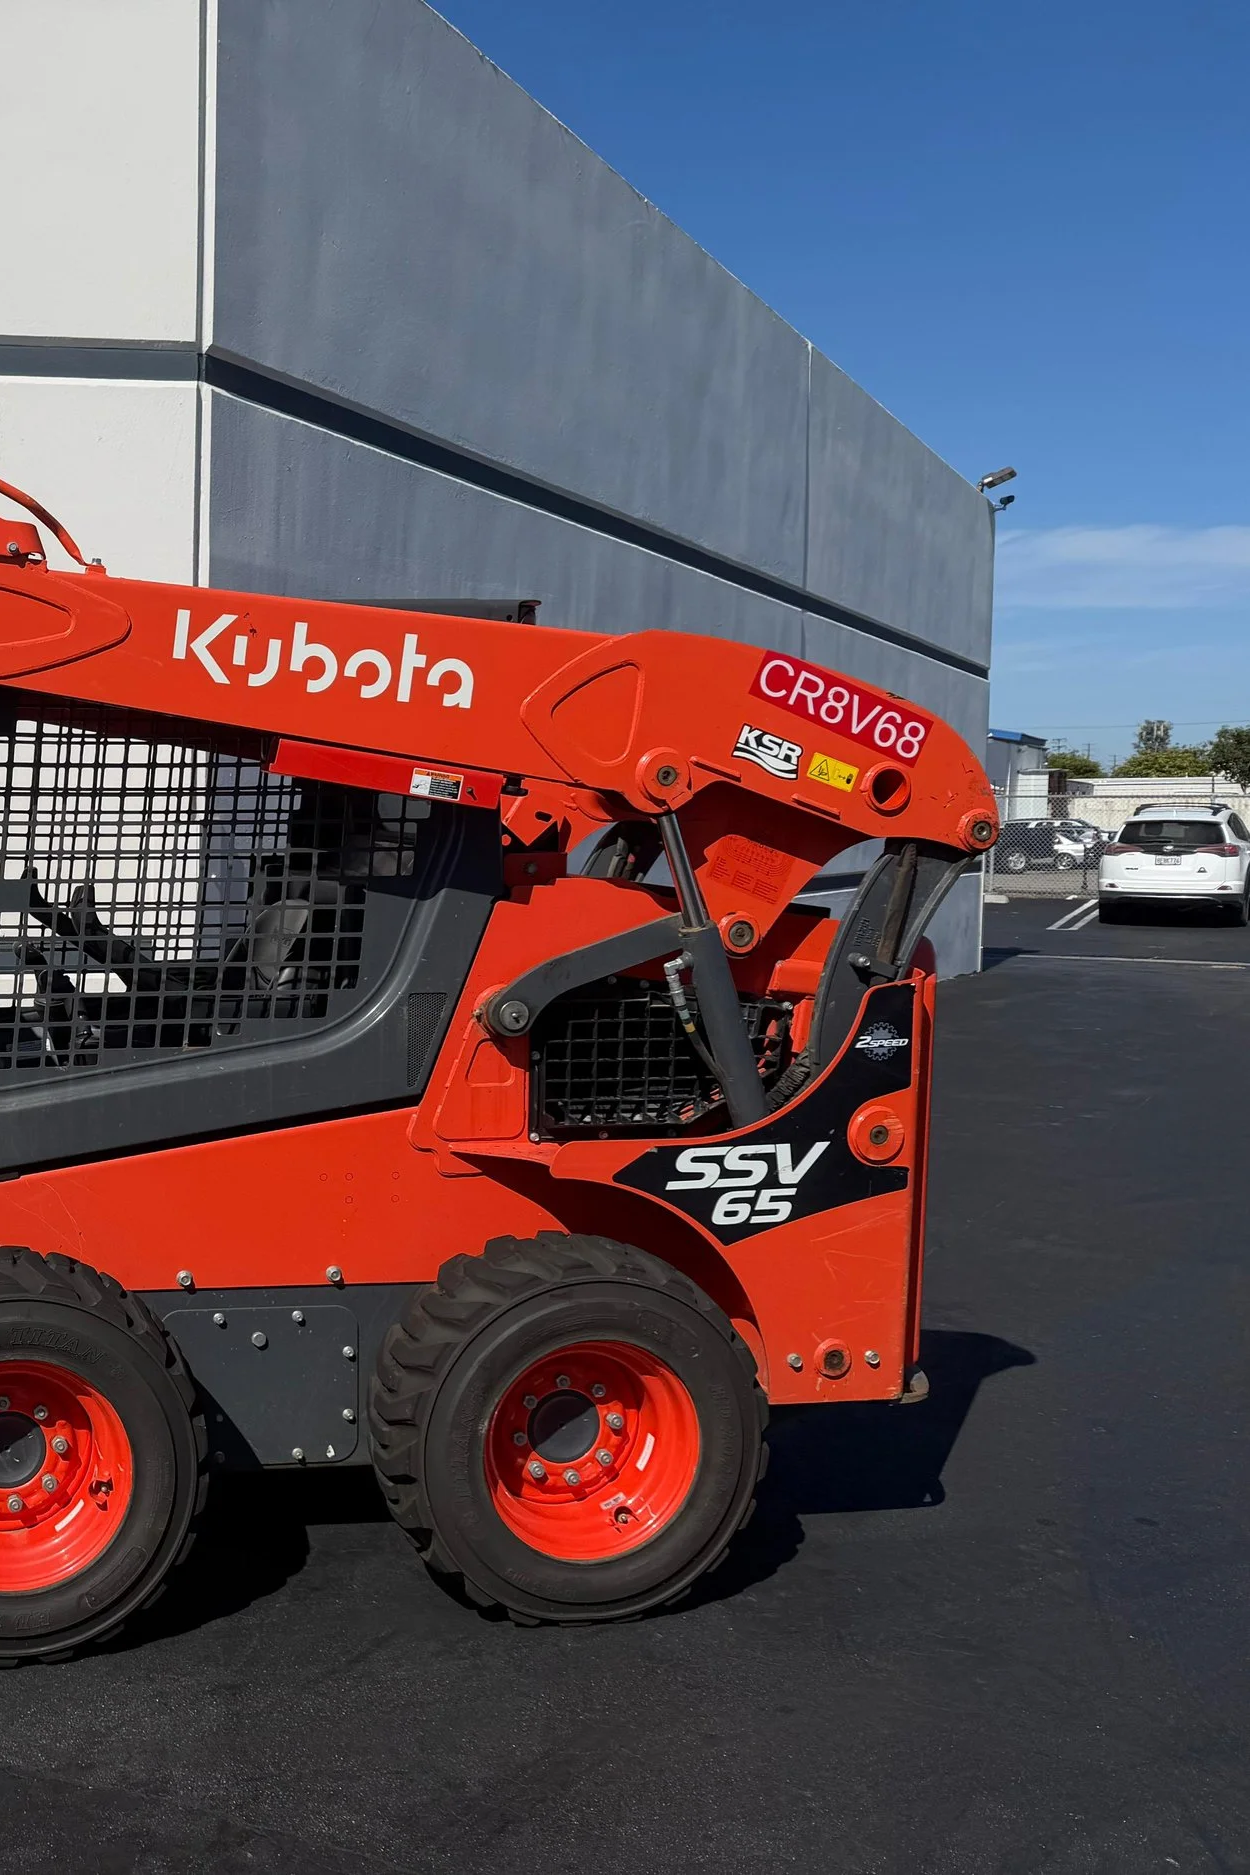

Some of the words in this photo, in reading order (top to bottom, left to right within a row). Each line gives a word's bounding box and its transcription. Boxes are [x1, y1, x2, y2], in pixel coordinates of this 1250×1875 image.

[172, 609, 474, 709] Kubota
[759, 659, 926, 759] CR8V68
[738, 725, 802, 766] KSR
[665, 1141, 831, 1190] SSV
[711, 1188, 798, 1225] 65
[10, 1327, 104, 1365] TITAN
